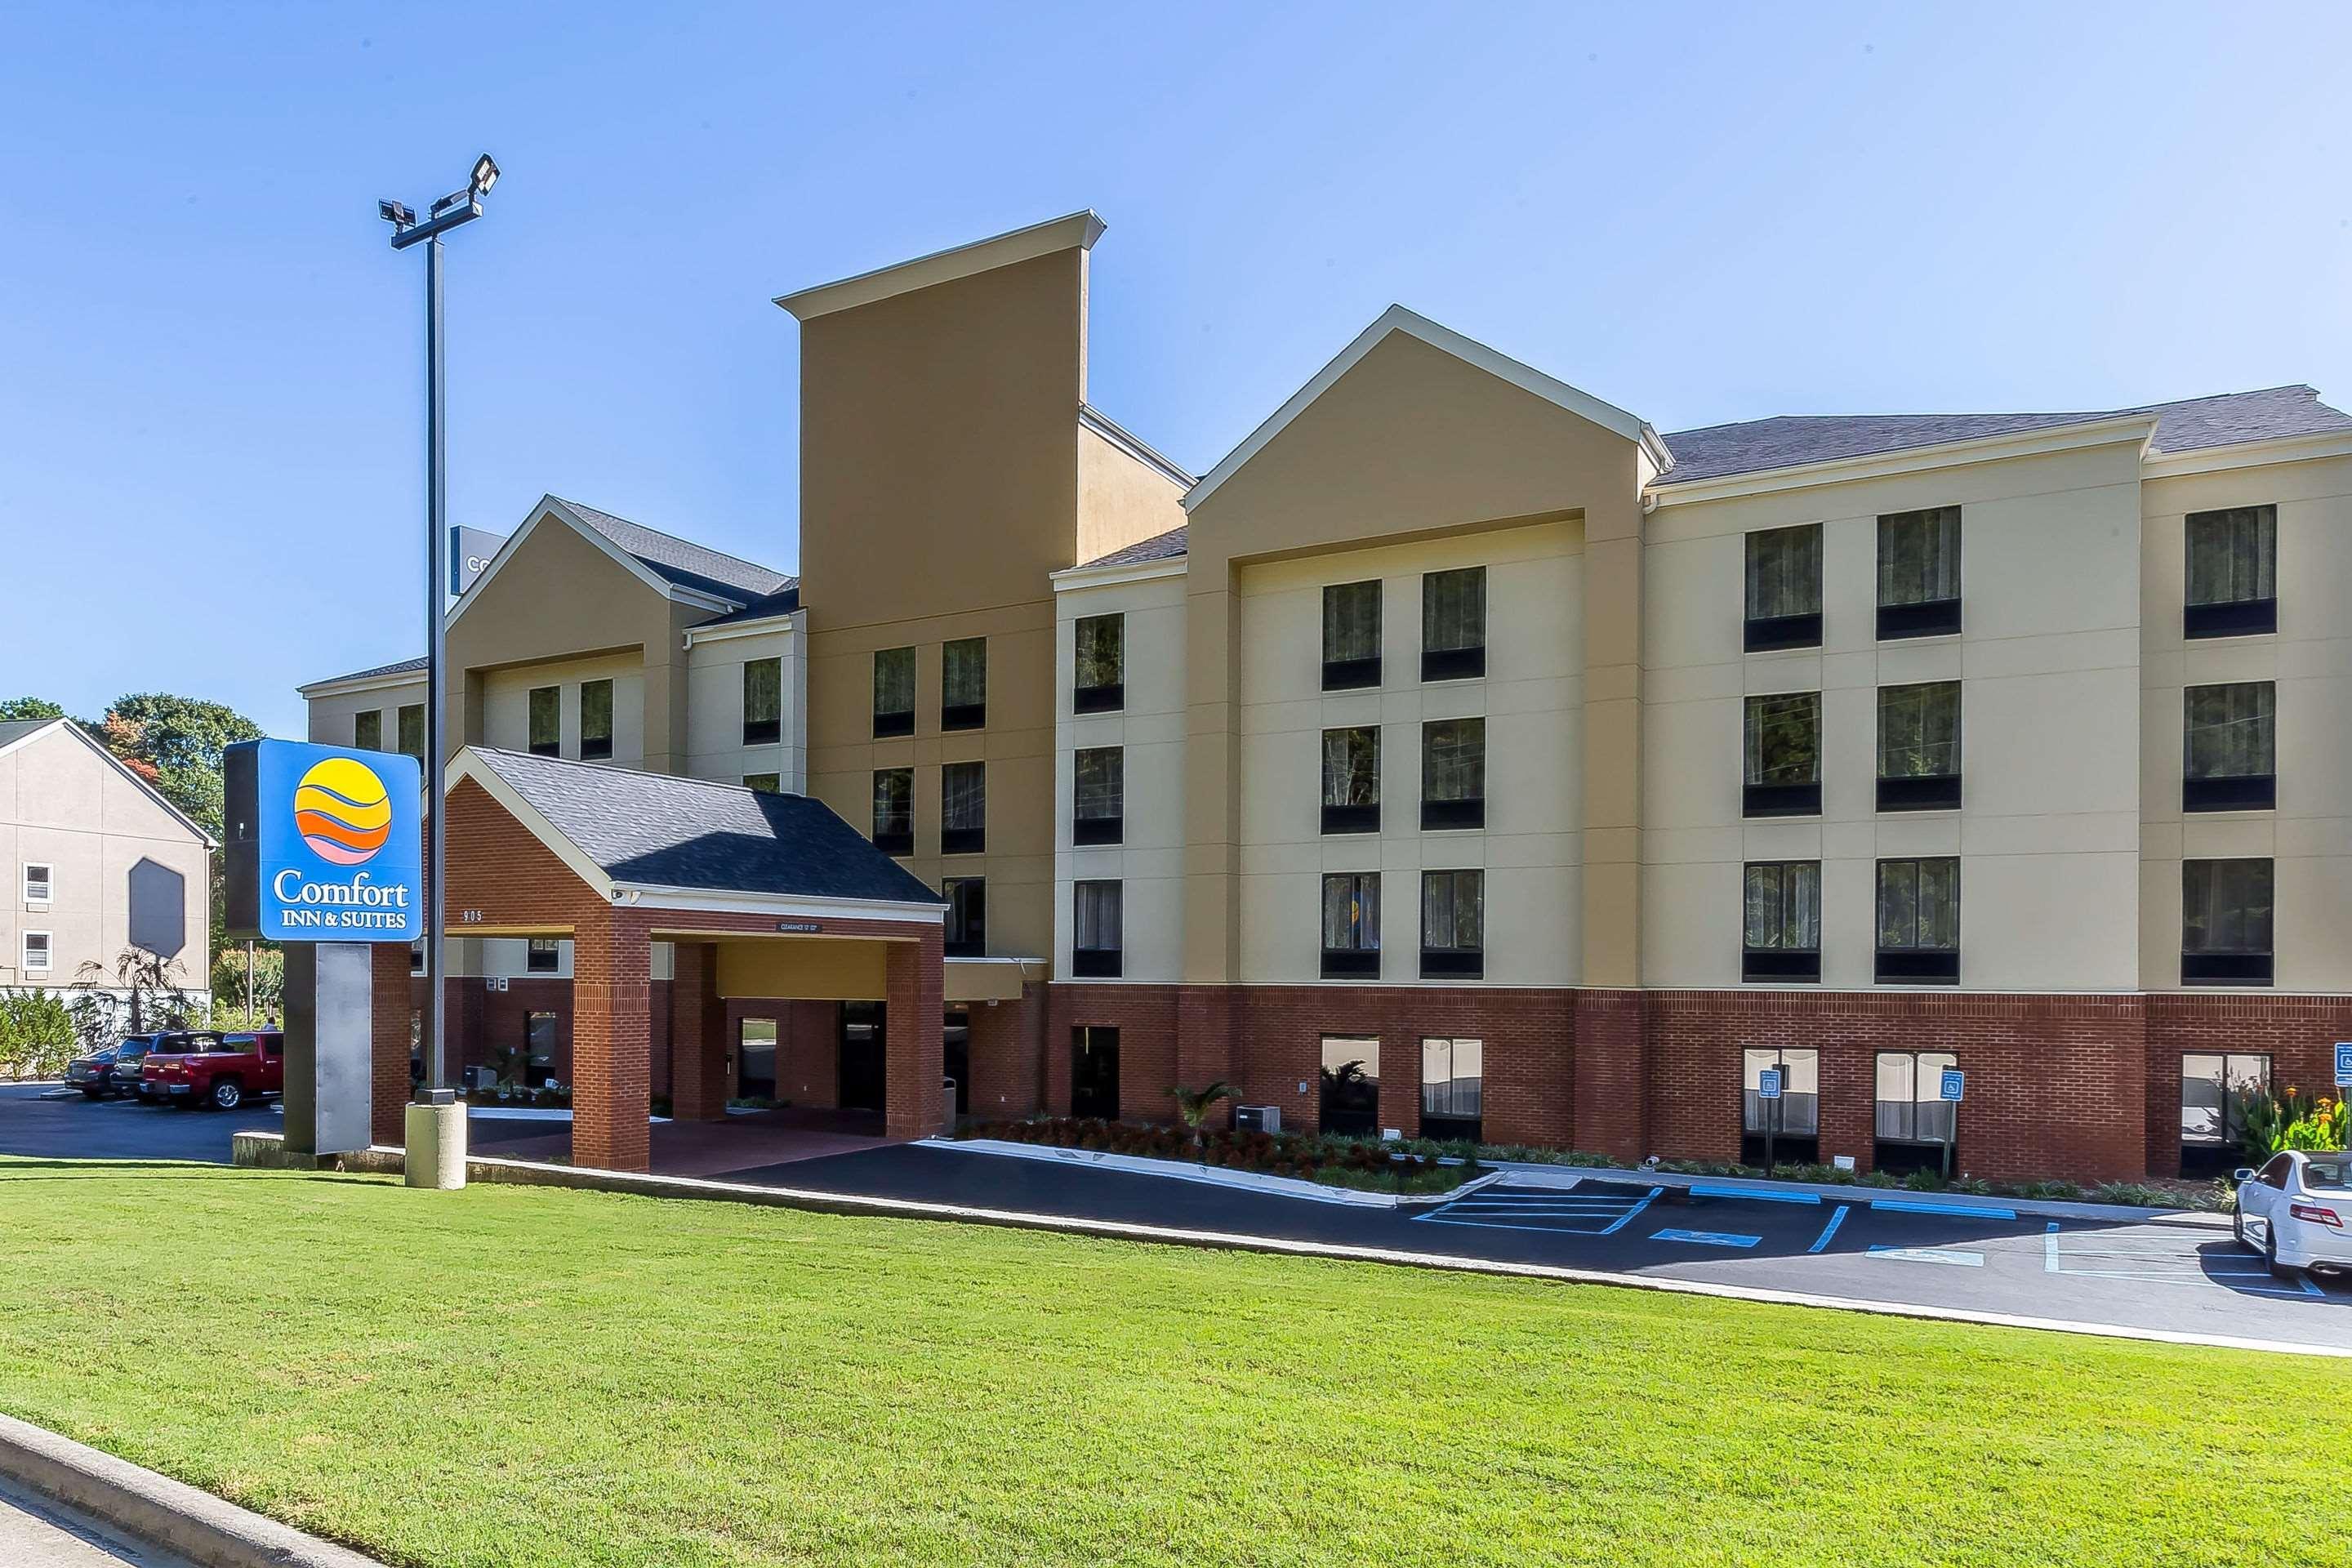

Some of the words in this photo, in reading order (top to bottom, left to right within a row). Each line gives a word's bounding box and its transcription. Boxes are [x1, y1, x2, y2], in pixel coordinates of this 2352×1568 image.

[273, 869, 409, 907] Comfort
[282, 910, 322, 927] INN
[324, 911, 339, 927] &
[341, 911, 407, 929] SUITES
[463, 910, 482, 921] 905
